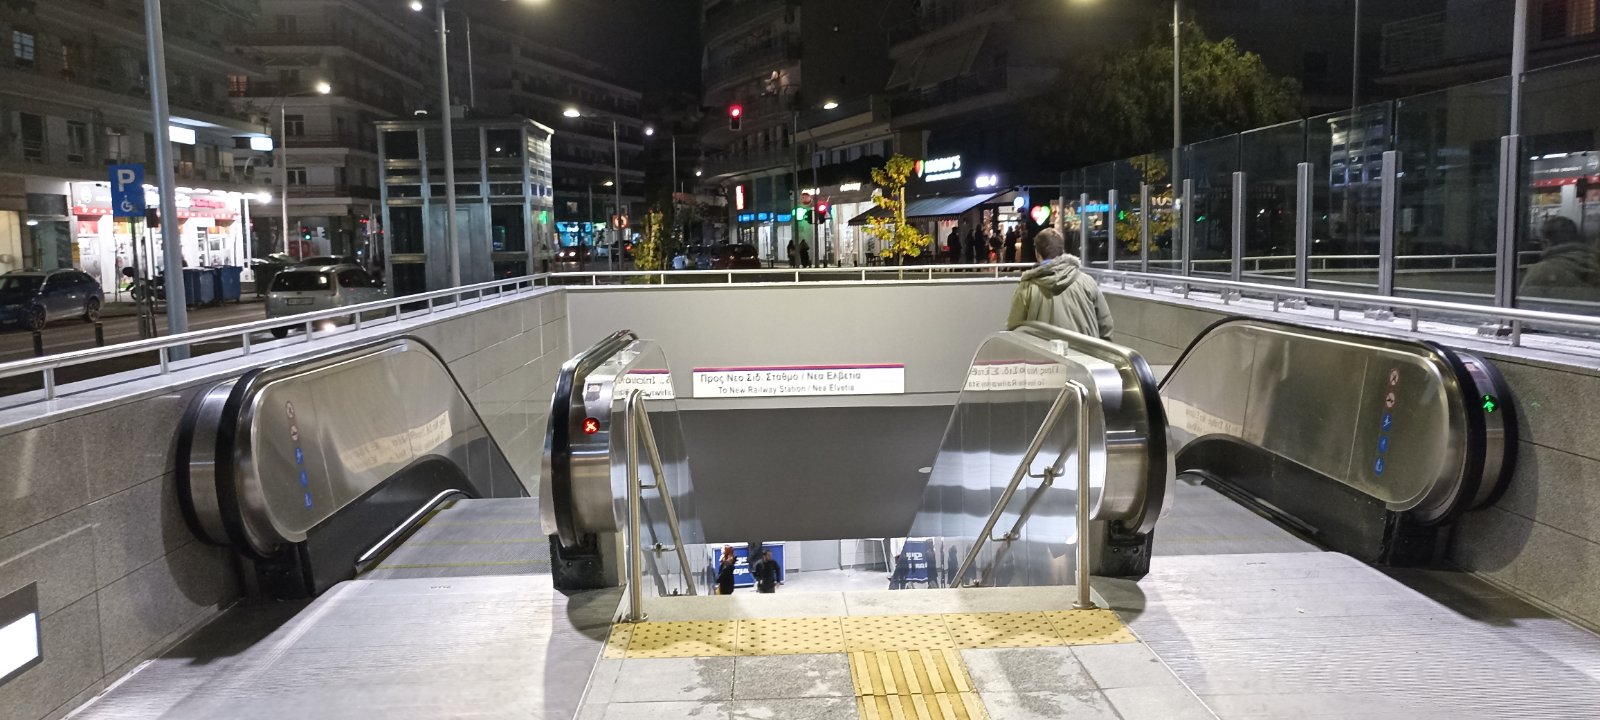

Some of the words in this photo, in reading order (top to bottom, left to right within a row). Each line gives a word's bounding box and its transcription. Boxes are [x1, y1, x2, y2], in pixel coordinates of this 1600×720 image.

[117, 169, 135, 192] P
[701, 373, 724, 384] Προς
[747, 373, 762, 382] Σιδ.
[718, 386, 727, 394] To
[729, 386, 745, 394] New
[748, 385, 777, 394] Railway
[780, 385, 806, 393] Station
[812, 384, 827, 392] Nea
[829, 383, 855, 392] Elvetia
